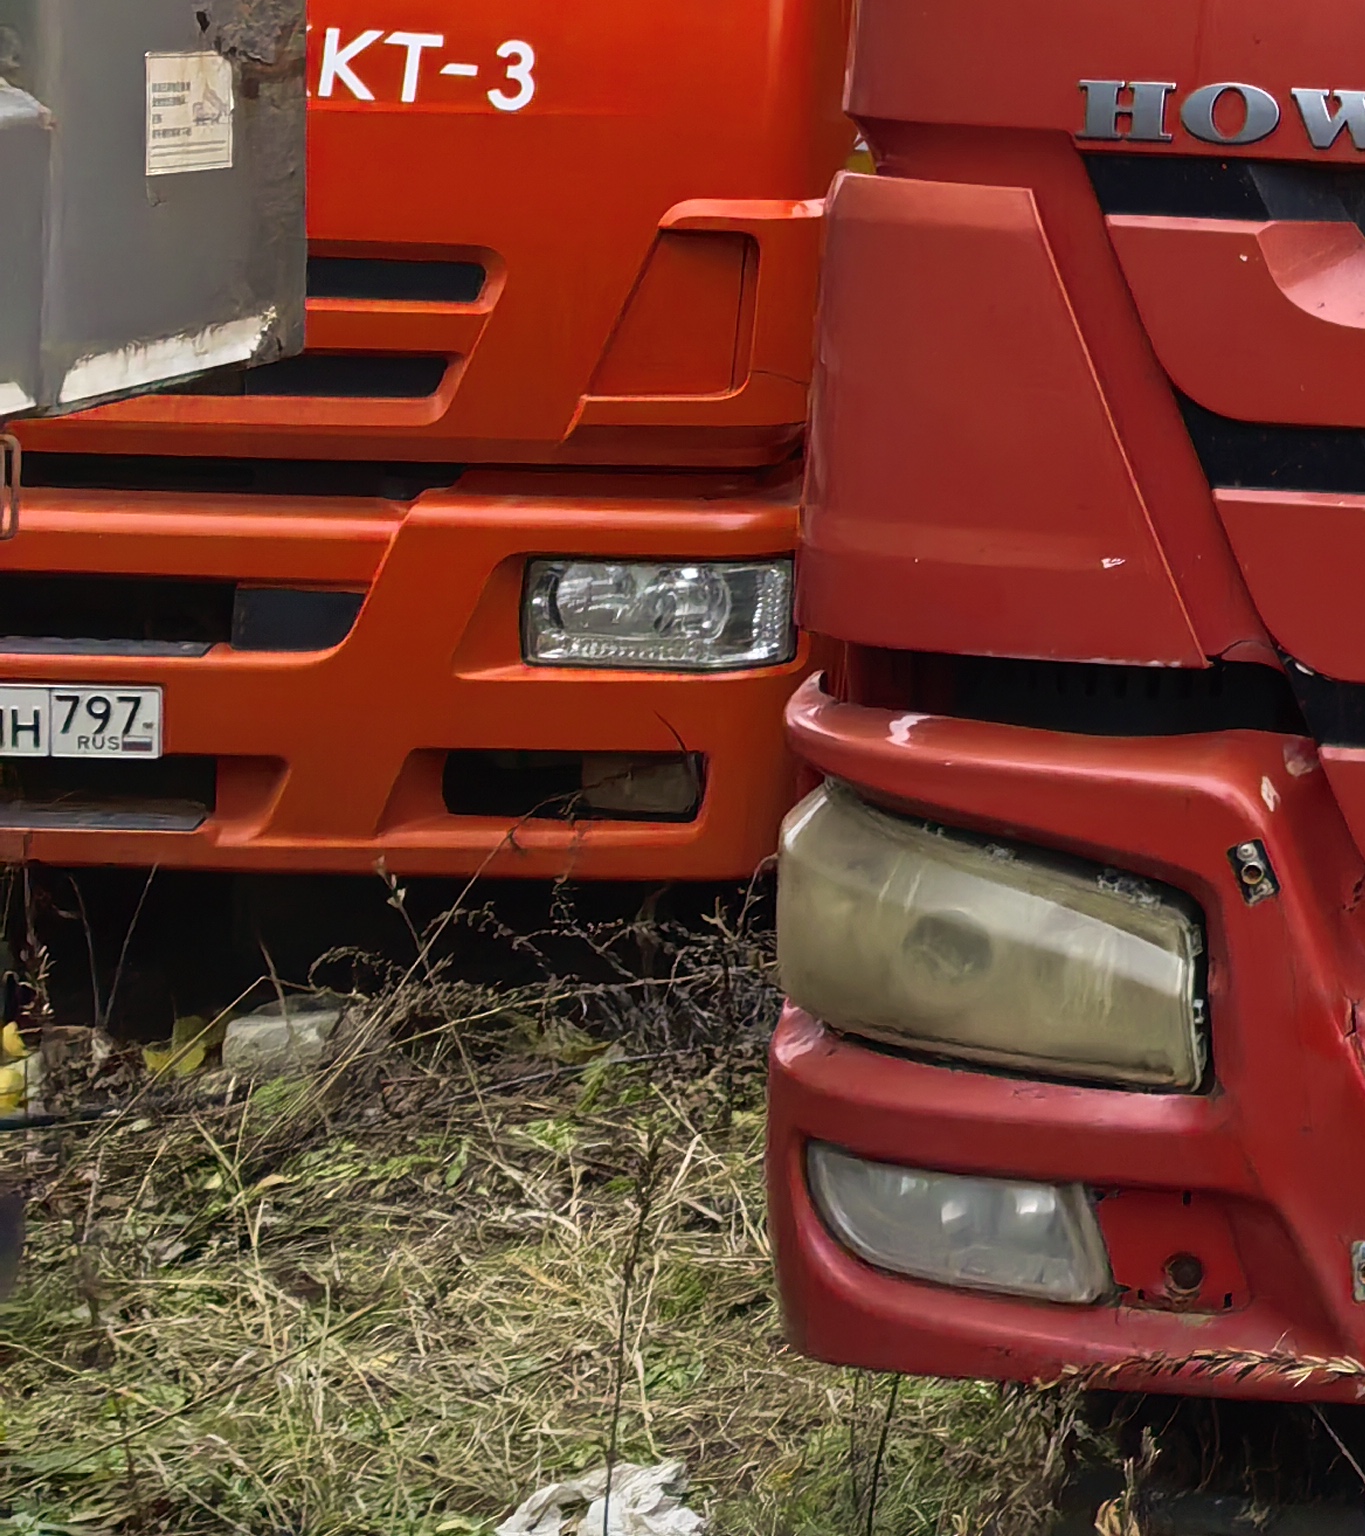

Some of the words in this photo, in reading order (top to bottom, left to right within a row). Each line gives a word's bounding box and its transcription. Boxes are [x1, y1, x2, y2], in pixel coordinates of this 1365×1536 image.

[307, 25, 535, 111] КТ-3
[54, 695, 141, 734] 797
[77, 735, 120, 750] RUS
